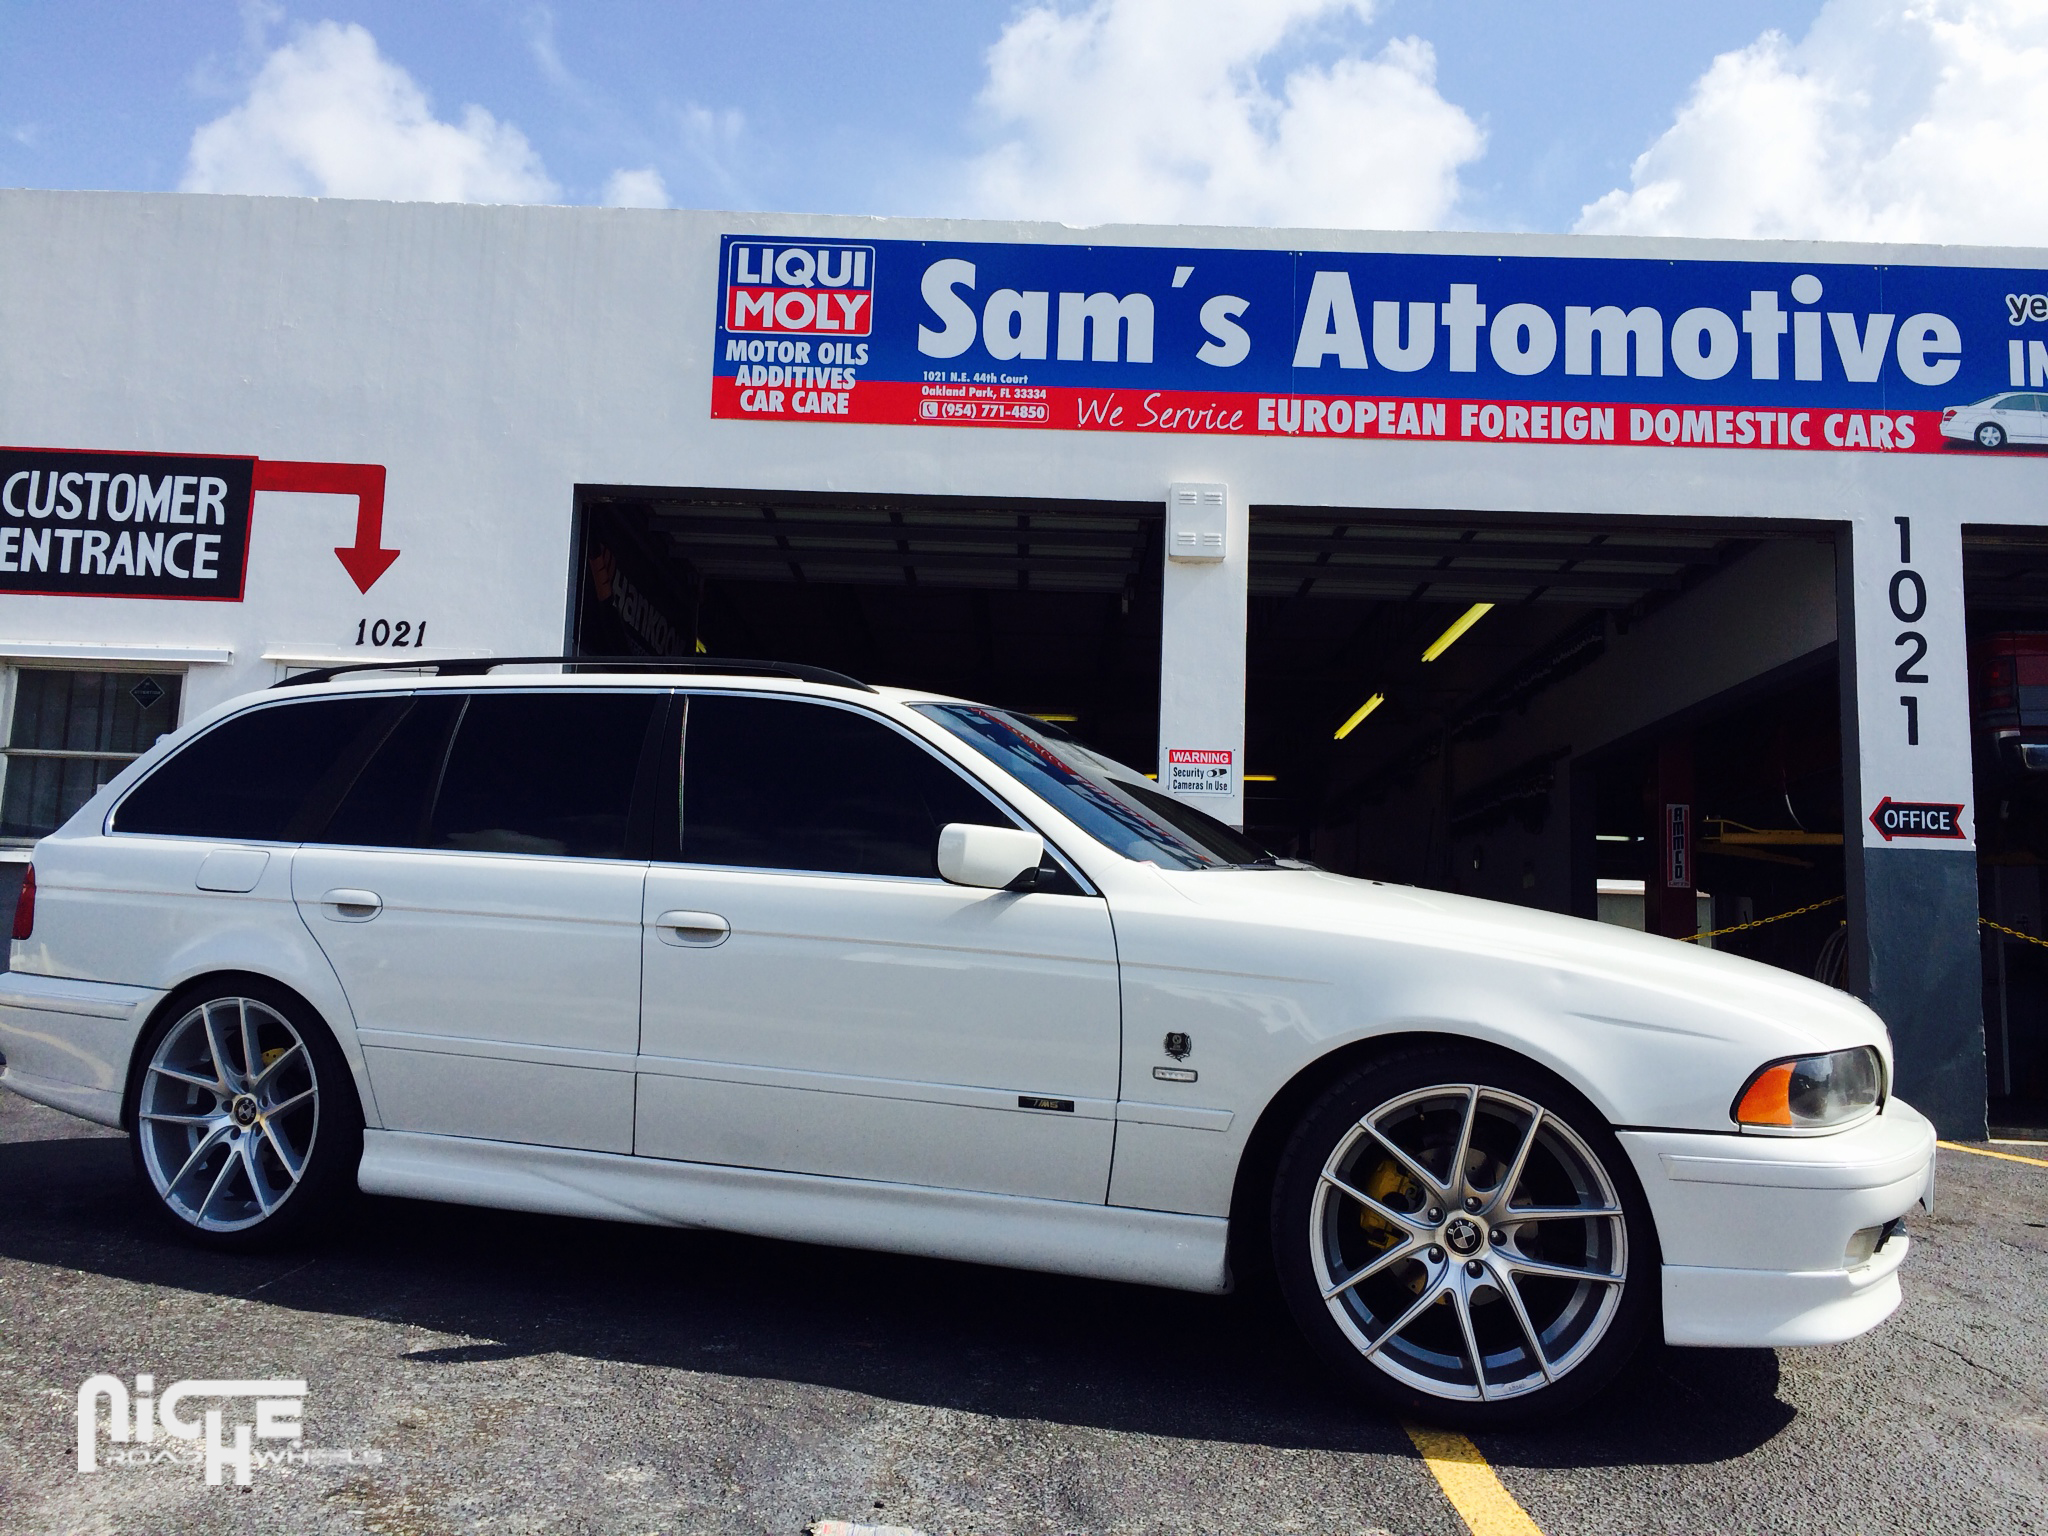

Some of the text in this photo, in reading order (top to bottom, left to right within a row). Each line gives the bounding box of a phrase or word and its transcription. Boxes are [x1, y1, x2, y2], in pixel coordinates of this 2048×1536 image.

[737, 247, 867, 288] LIQUI
[734, 290, 869, 330] MOLY
[1292, 271, 1962, 386] Automotive
[725, 339, 869, 366] MOTOR OILS
[735, 365, 856, 390] ADDITIVES
[923, 371, 1028, 384] 1021 N.E. 44th Court
[740, 390, 850, 414] CAR CARE
[921, 386, 1047, 400] Oakland Park, FL 33334
[942, 403, 1045, 419] (954) 771-4850
[1078, 392, 1916, 450] We Service EUROPEAN FOREIGN DOMESTIC CARS
[3, 470, 228, 526] CUSTOMER
[0, 526, 222, 579] ENTRANCE
[356, 618, 427, 648] 1021
[1888, 516, 1929, 746] 1021
[1172, 751, 1229, 764] WARNING
[1173, 767, 1204, 779] Security
[1173, 780, 1228, 791] Cameras In Use
[1883, 809, 1951, 831] OFFICE
